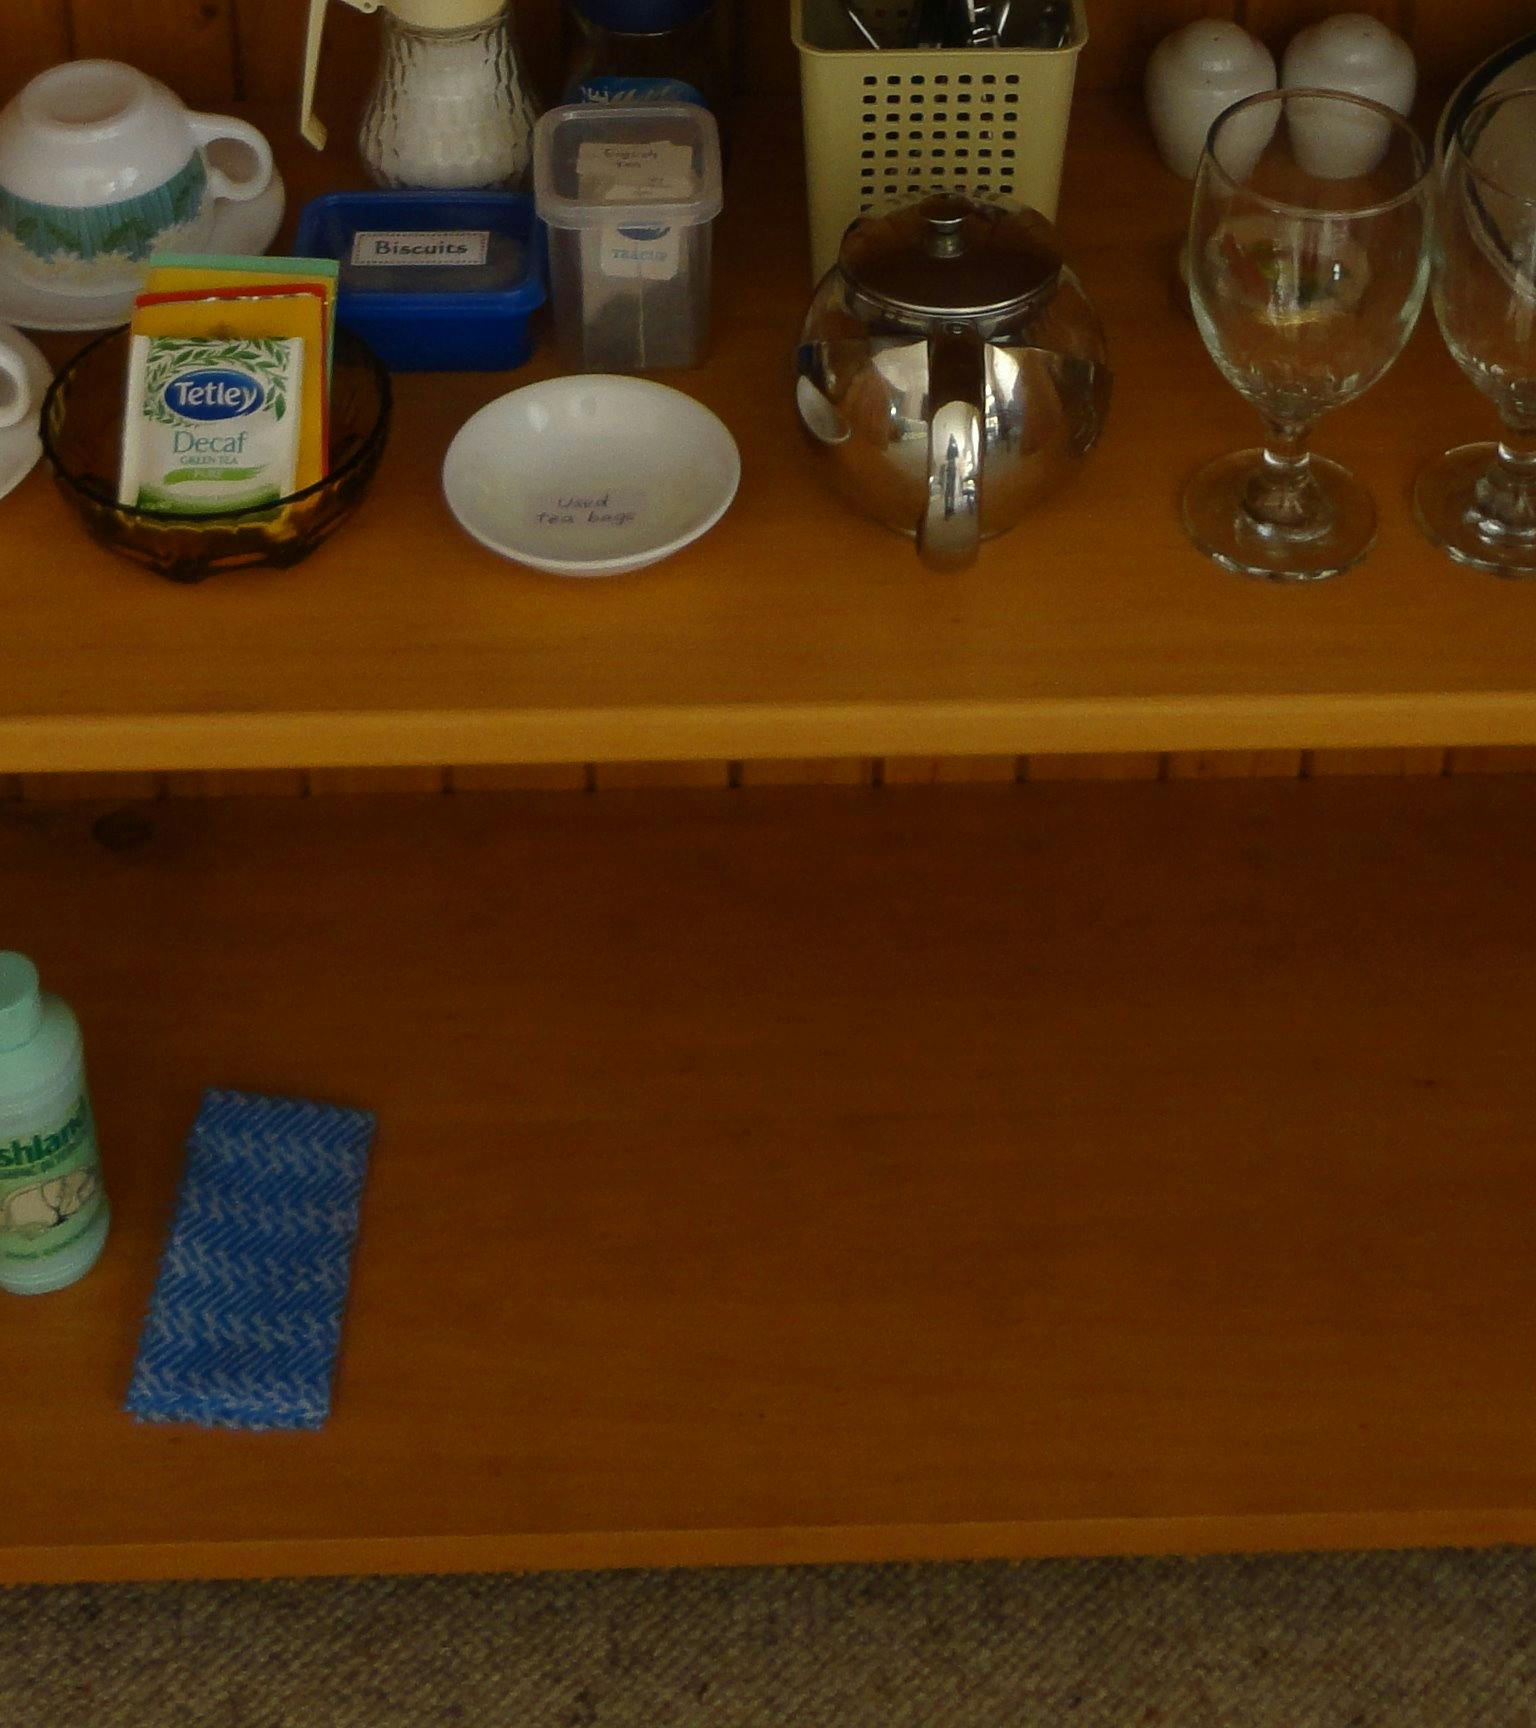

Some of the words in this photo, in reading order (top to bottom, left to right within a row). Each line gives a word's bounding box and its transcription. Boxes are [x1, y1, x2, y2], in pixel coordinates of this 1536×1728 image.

[374, 240, 469, 255] Biscuits
[174, 381, 258, 413] Tetley
[173, 430, 247, 454] Decaf
[180, 455, 215, 466] GREEN
[218, 454, 239, 465] TEA
